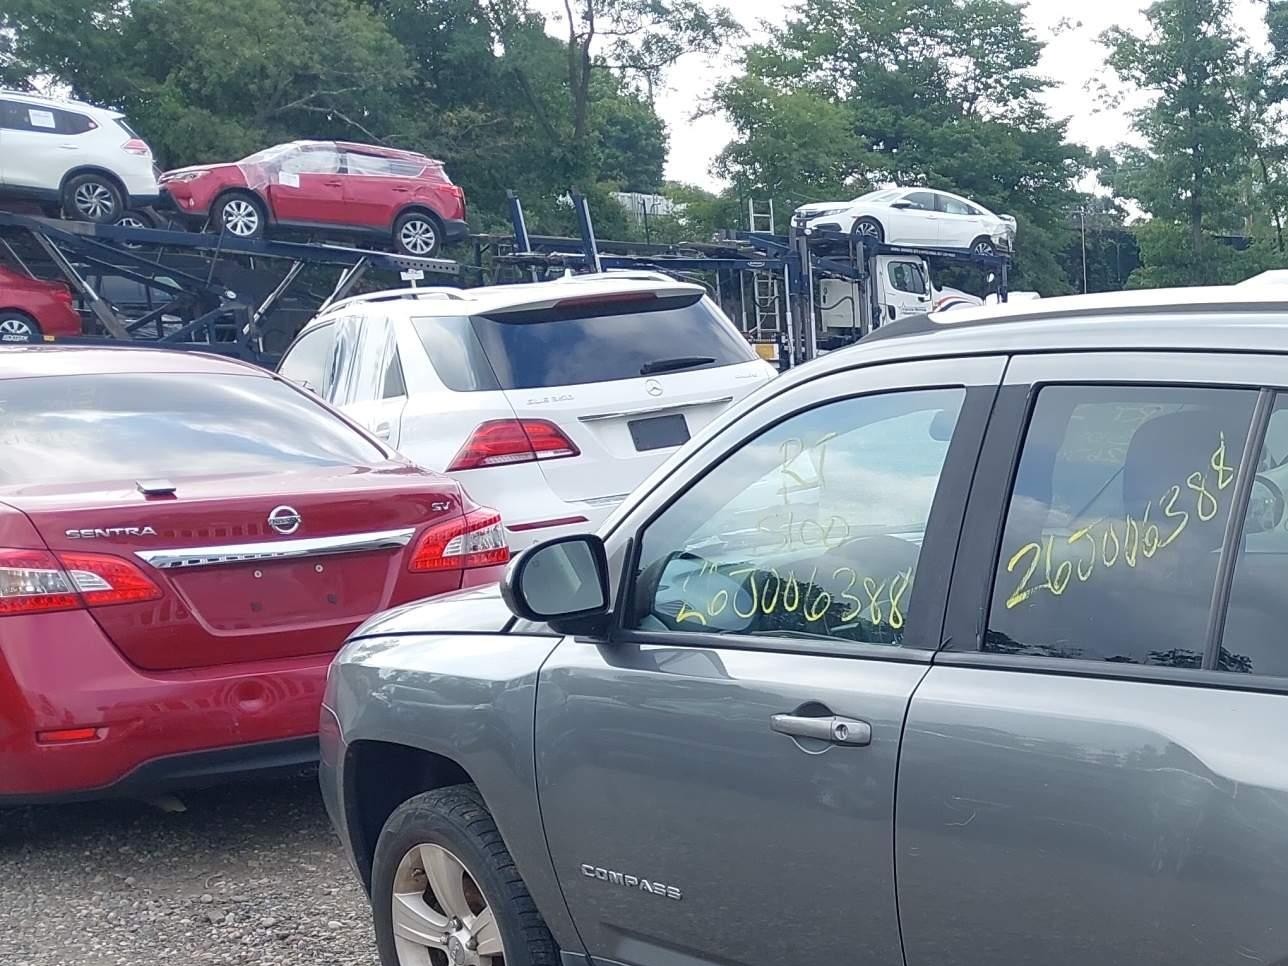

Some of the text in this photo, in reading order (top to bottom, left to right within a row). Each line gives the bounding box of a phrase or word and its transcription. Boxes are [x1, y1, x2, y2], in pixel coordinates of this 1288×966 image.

[431, 501, 450, 511] SV
[64, 526, 158, 540] SENTRA
[580, 863, 683, 901] COMPASS
